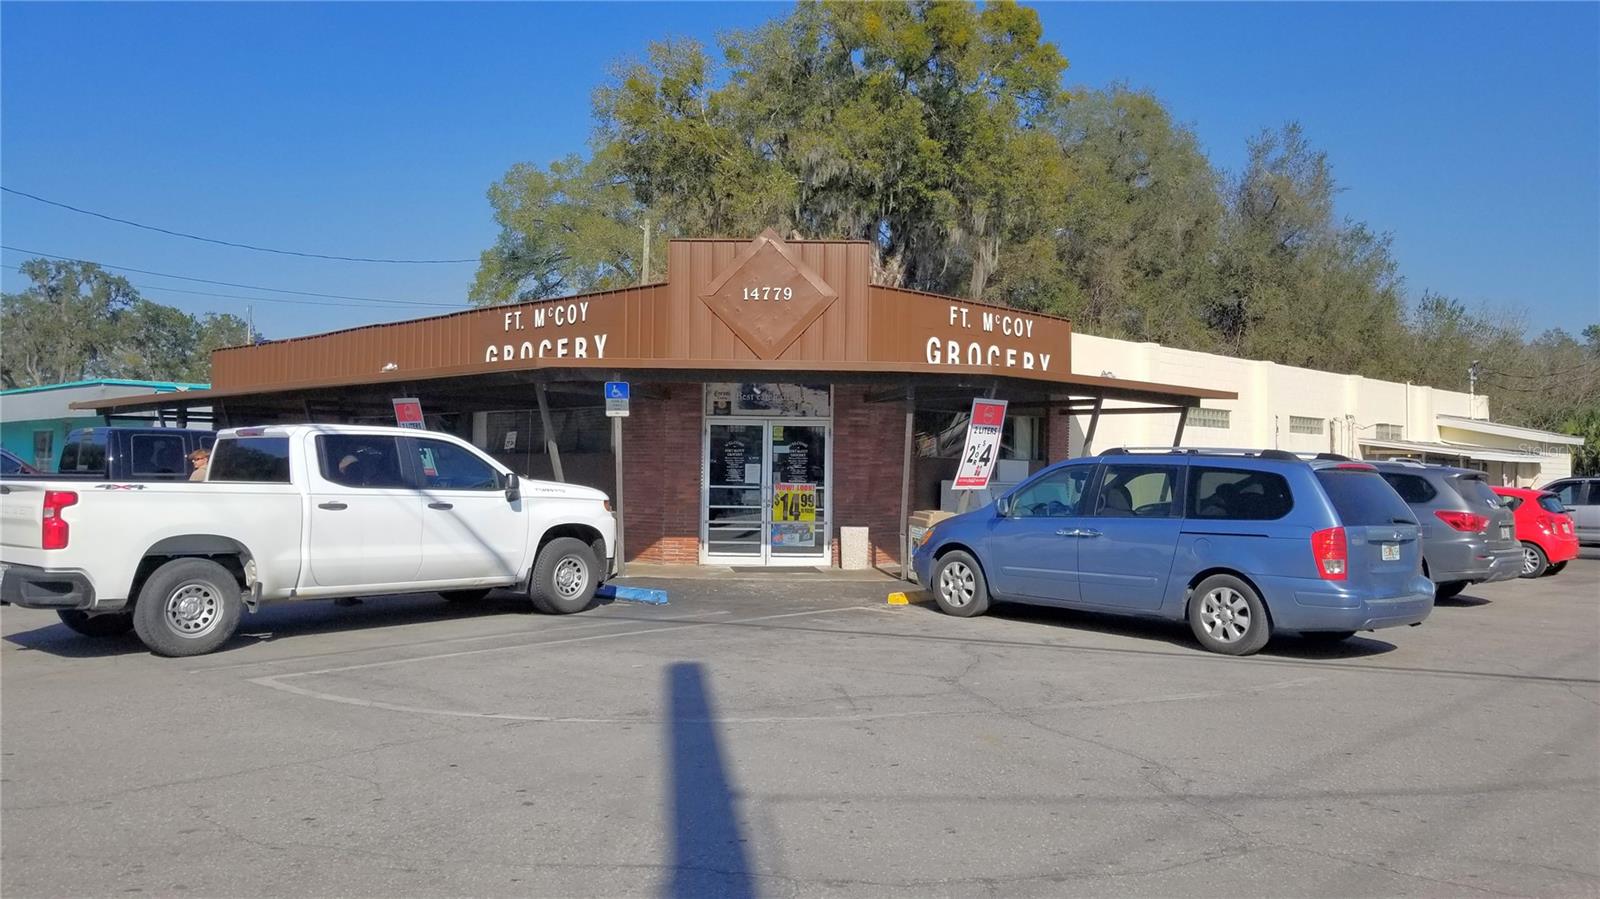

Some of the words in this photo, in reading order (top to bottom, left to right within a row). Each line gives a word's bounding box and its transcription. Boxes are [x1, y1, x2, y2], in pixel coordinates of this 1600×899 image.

[743, 287, 792, 301] 14779
[504, 311, 524, 331] FT.
[950, 306, 971, 328] FT.
[974, 426, 979, 434] 2
[979, 426, 998, 435] LITERS
[967, 445, 976, 463] 2
